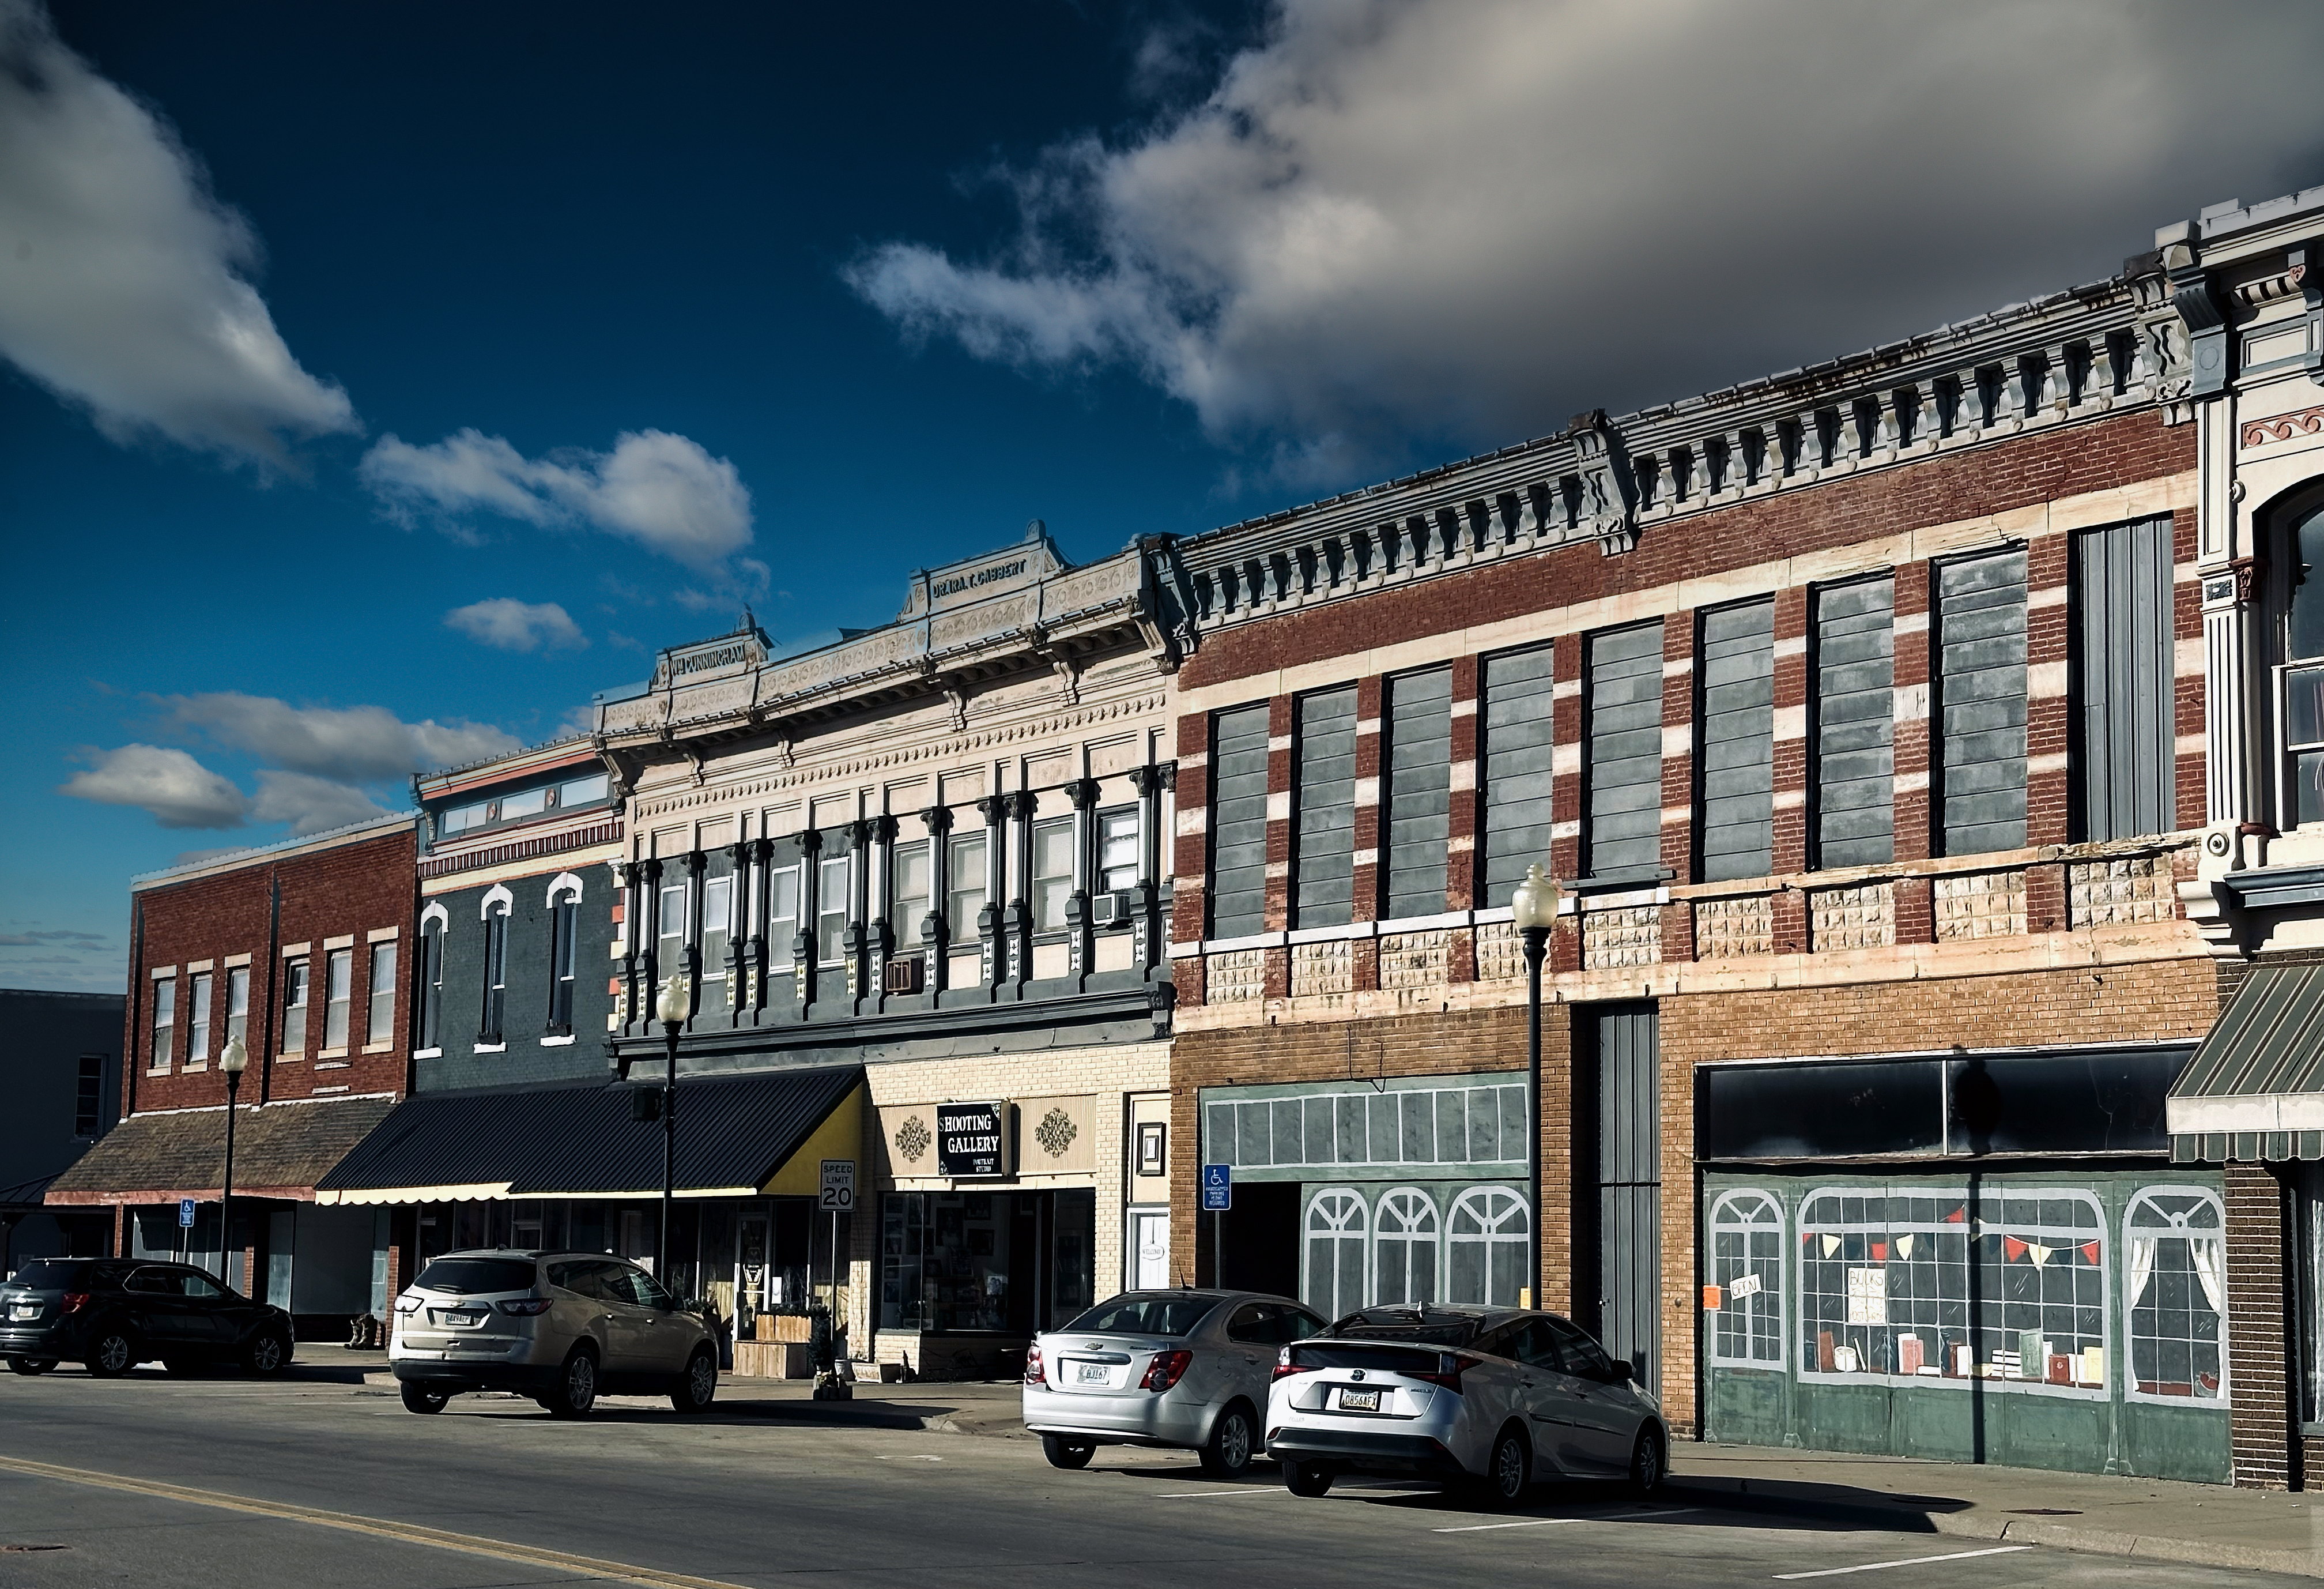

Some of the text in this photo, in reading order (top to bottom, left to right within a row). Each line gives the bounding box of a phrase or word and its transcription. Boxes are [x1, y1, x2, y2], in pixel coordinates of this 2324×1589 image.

[938, 1114, 991, 1132] SHOOTING
[948, 1136, 999, 1153] GALLERY
[824, 1165, 852, 1173] SPEED
[823, 1187, 851, 1206] 20
[1850, 1271, 1884, 1286] BOOKS
